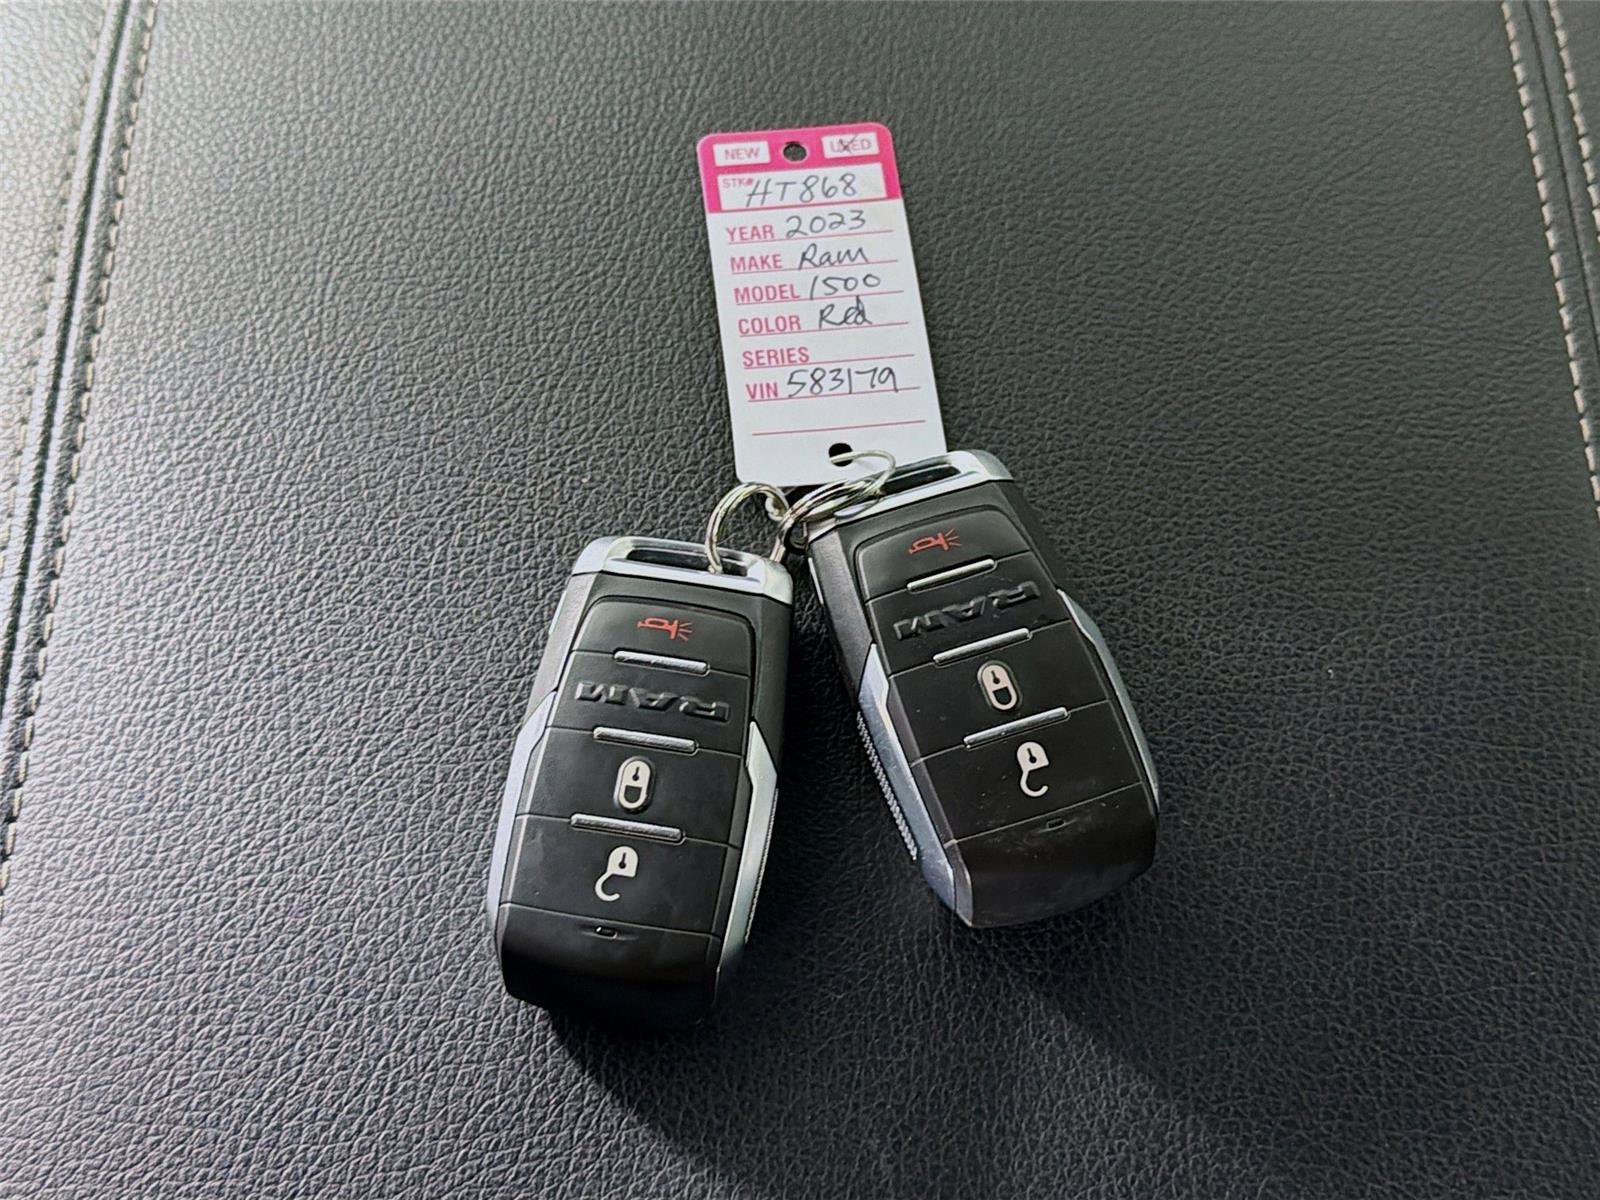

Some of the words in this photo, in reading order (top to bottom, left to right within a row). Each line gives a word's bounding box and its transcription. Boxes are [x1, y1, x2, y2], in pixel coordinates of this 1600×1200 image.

[724, 146, 760, 161] NEW
[746, 172, 857, 208] HT868
[726, 224, 775, 242] YEAR
[785, 209, 866, 240] 2023
[730, 254, 784, 272] MAKE
[798, 242, 869, 271] Ram
[734, 283, 800, 301] MODEL
[809, 273, 881, 301] 1500
[738, 314, 802, 335] COLOR
[819, 295, 873, 330] Red
[742, 346, 810, 368] SERIES
[746, 381, 779, 400] VIN
[787, 366, 899, 399] 583179
[893, 580, 1041, 641] RAM
[574, 682, 730, 723] RAM
